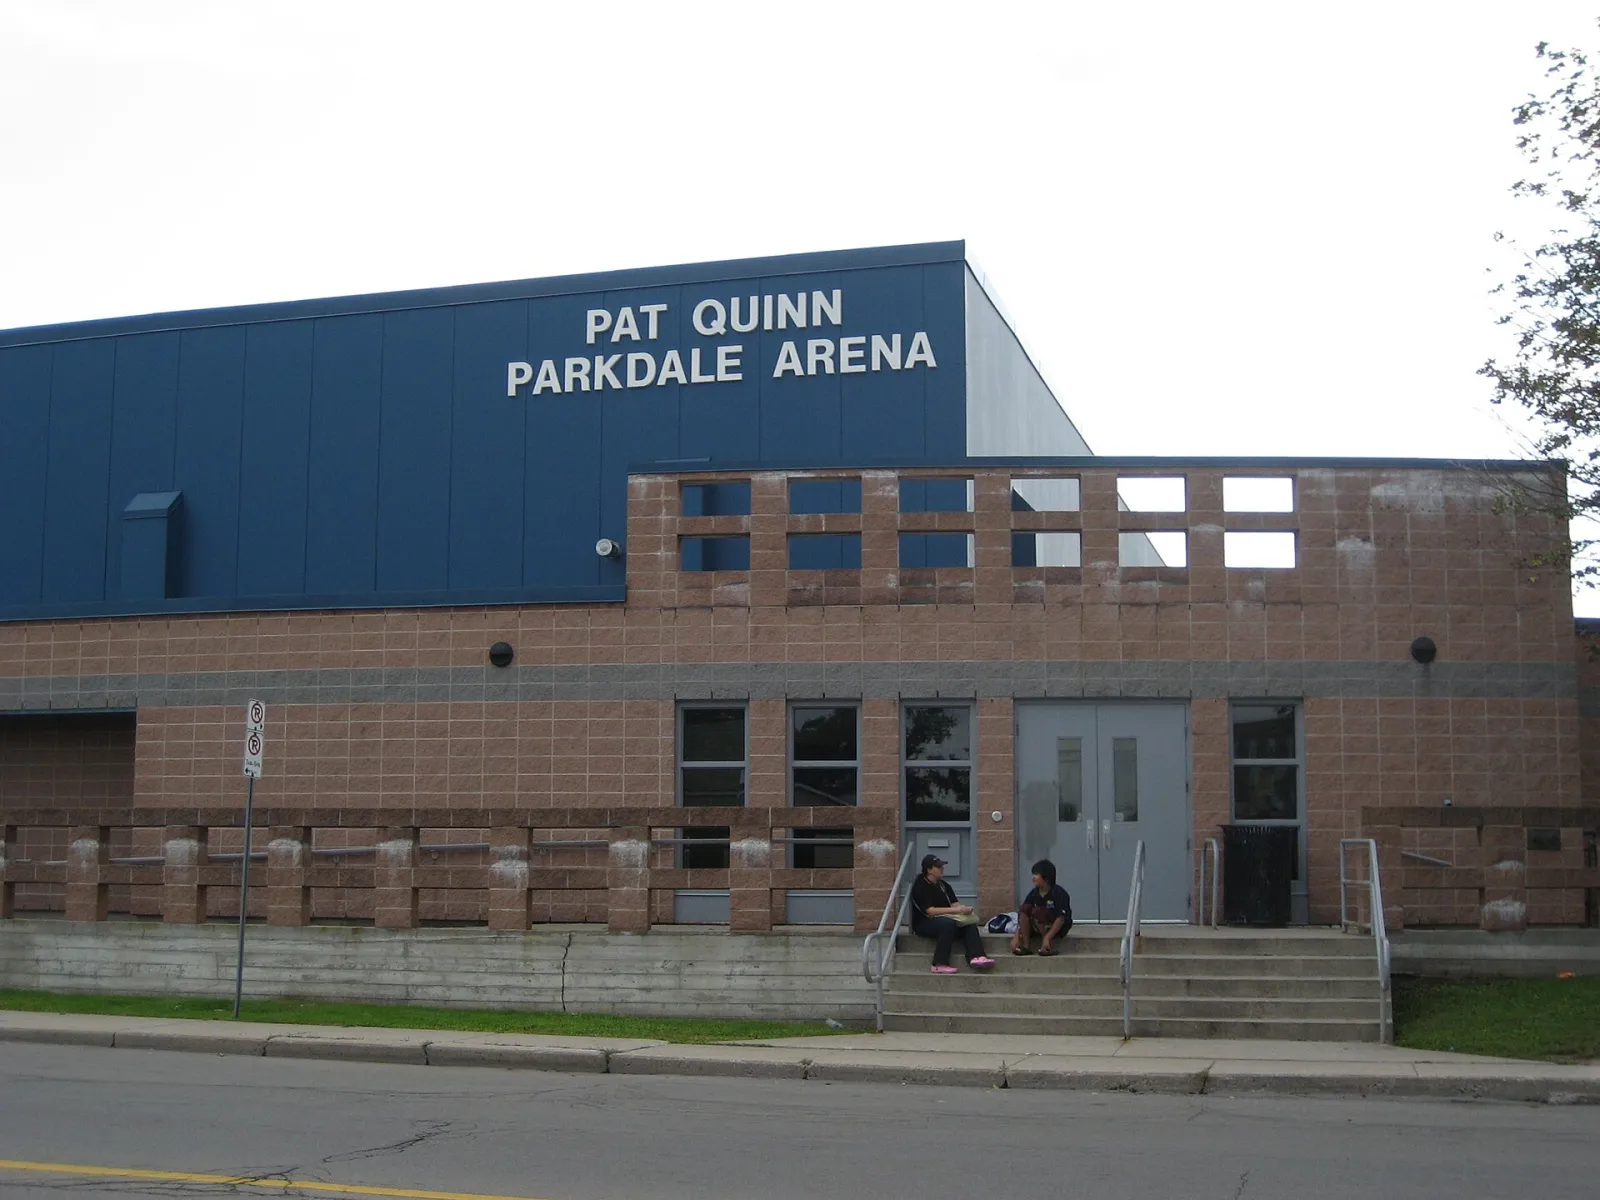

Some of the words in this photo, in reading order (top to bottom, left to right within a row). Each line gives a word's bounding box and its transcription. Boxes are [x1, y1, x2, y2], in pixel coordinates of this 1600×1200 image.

[586, 303, 668, 344] PAT
[692, 289, 843, 337] QUINN
[507, 345, 743, 397] PARKDALE
[773, 331, 938, 378] ARENA
